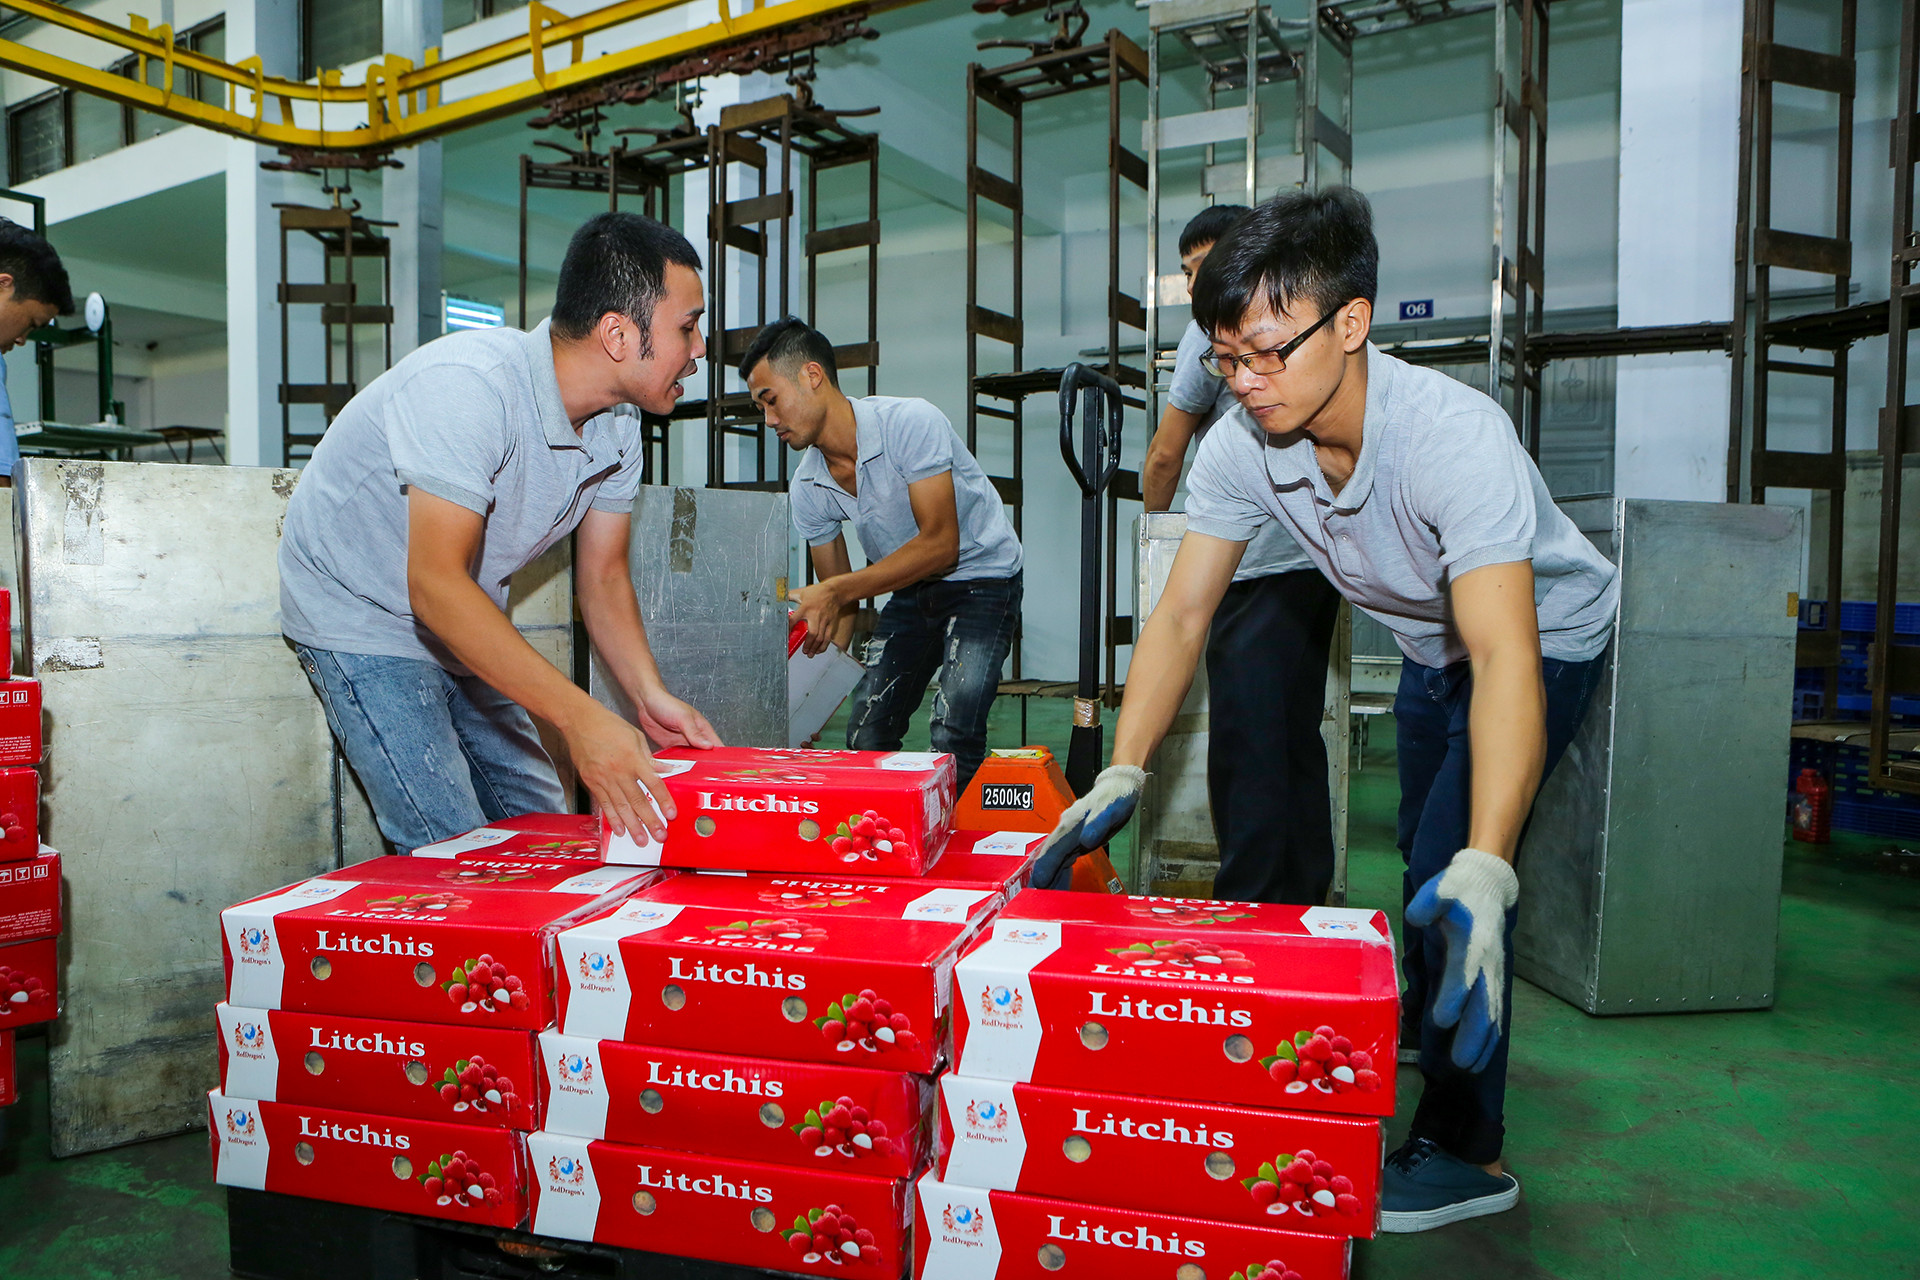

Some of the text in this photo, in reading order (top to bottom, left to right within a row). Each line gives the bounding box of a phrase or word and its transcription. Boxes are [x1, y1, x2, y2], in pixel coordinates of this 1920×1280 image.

[1406, 303, 1427, 316] 06
[700, 792, 819, 814] Litchis
[984, 788, 1031, 809] 2500kg
[459, 860, 565, 871] Litchis
[771, 880, 890, 894] Litchis
[325, 909, 447, 922] Litchis
[316, 930, 434, 957] Litchis
[674, 936, 815, 953] Litchis
[241, 956, 271, 966] RedDragon's
[668, 957, 806, 990] Litchis
[1091, 963, 1255, 984] Litchis
[580, 982, 615, 993] RedDragon's
[1088, 991, 1252, 1027] Litchis
[981, 1018, 1023, 1030] RedDragon's
[309, 1027, 425, 1057] Litchis
[646, 1061, 783, 1098] Litchis
[559, 1084, 594, 1095] RedDragon's
[298, 1116, 411, 1150] Litchis
[966, 1131, 1008, 1144] RedDragon's
[1072, 1108, 1234, 1148] Litchis
[550, 1185, 585, 1197] RedDragon's
[637, 1165, 773, 1203] Litchis
[942, 1235, 984, 1248] RedDragon's
[1046, 1214, 1206, 1257] Litchis
